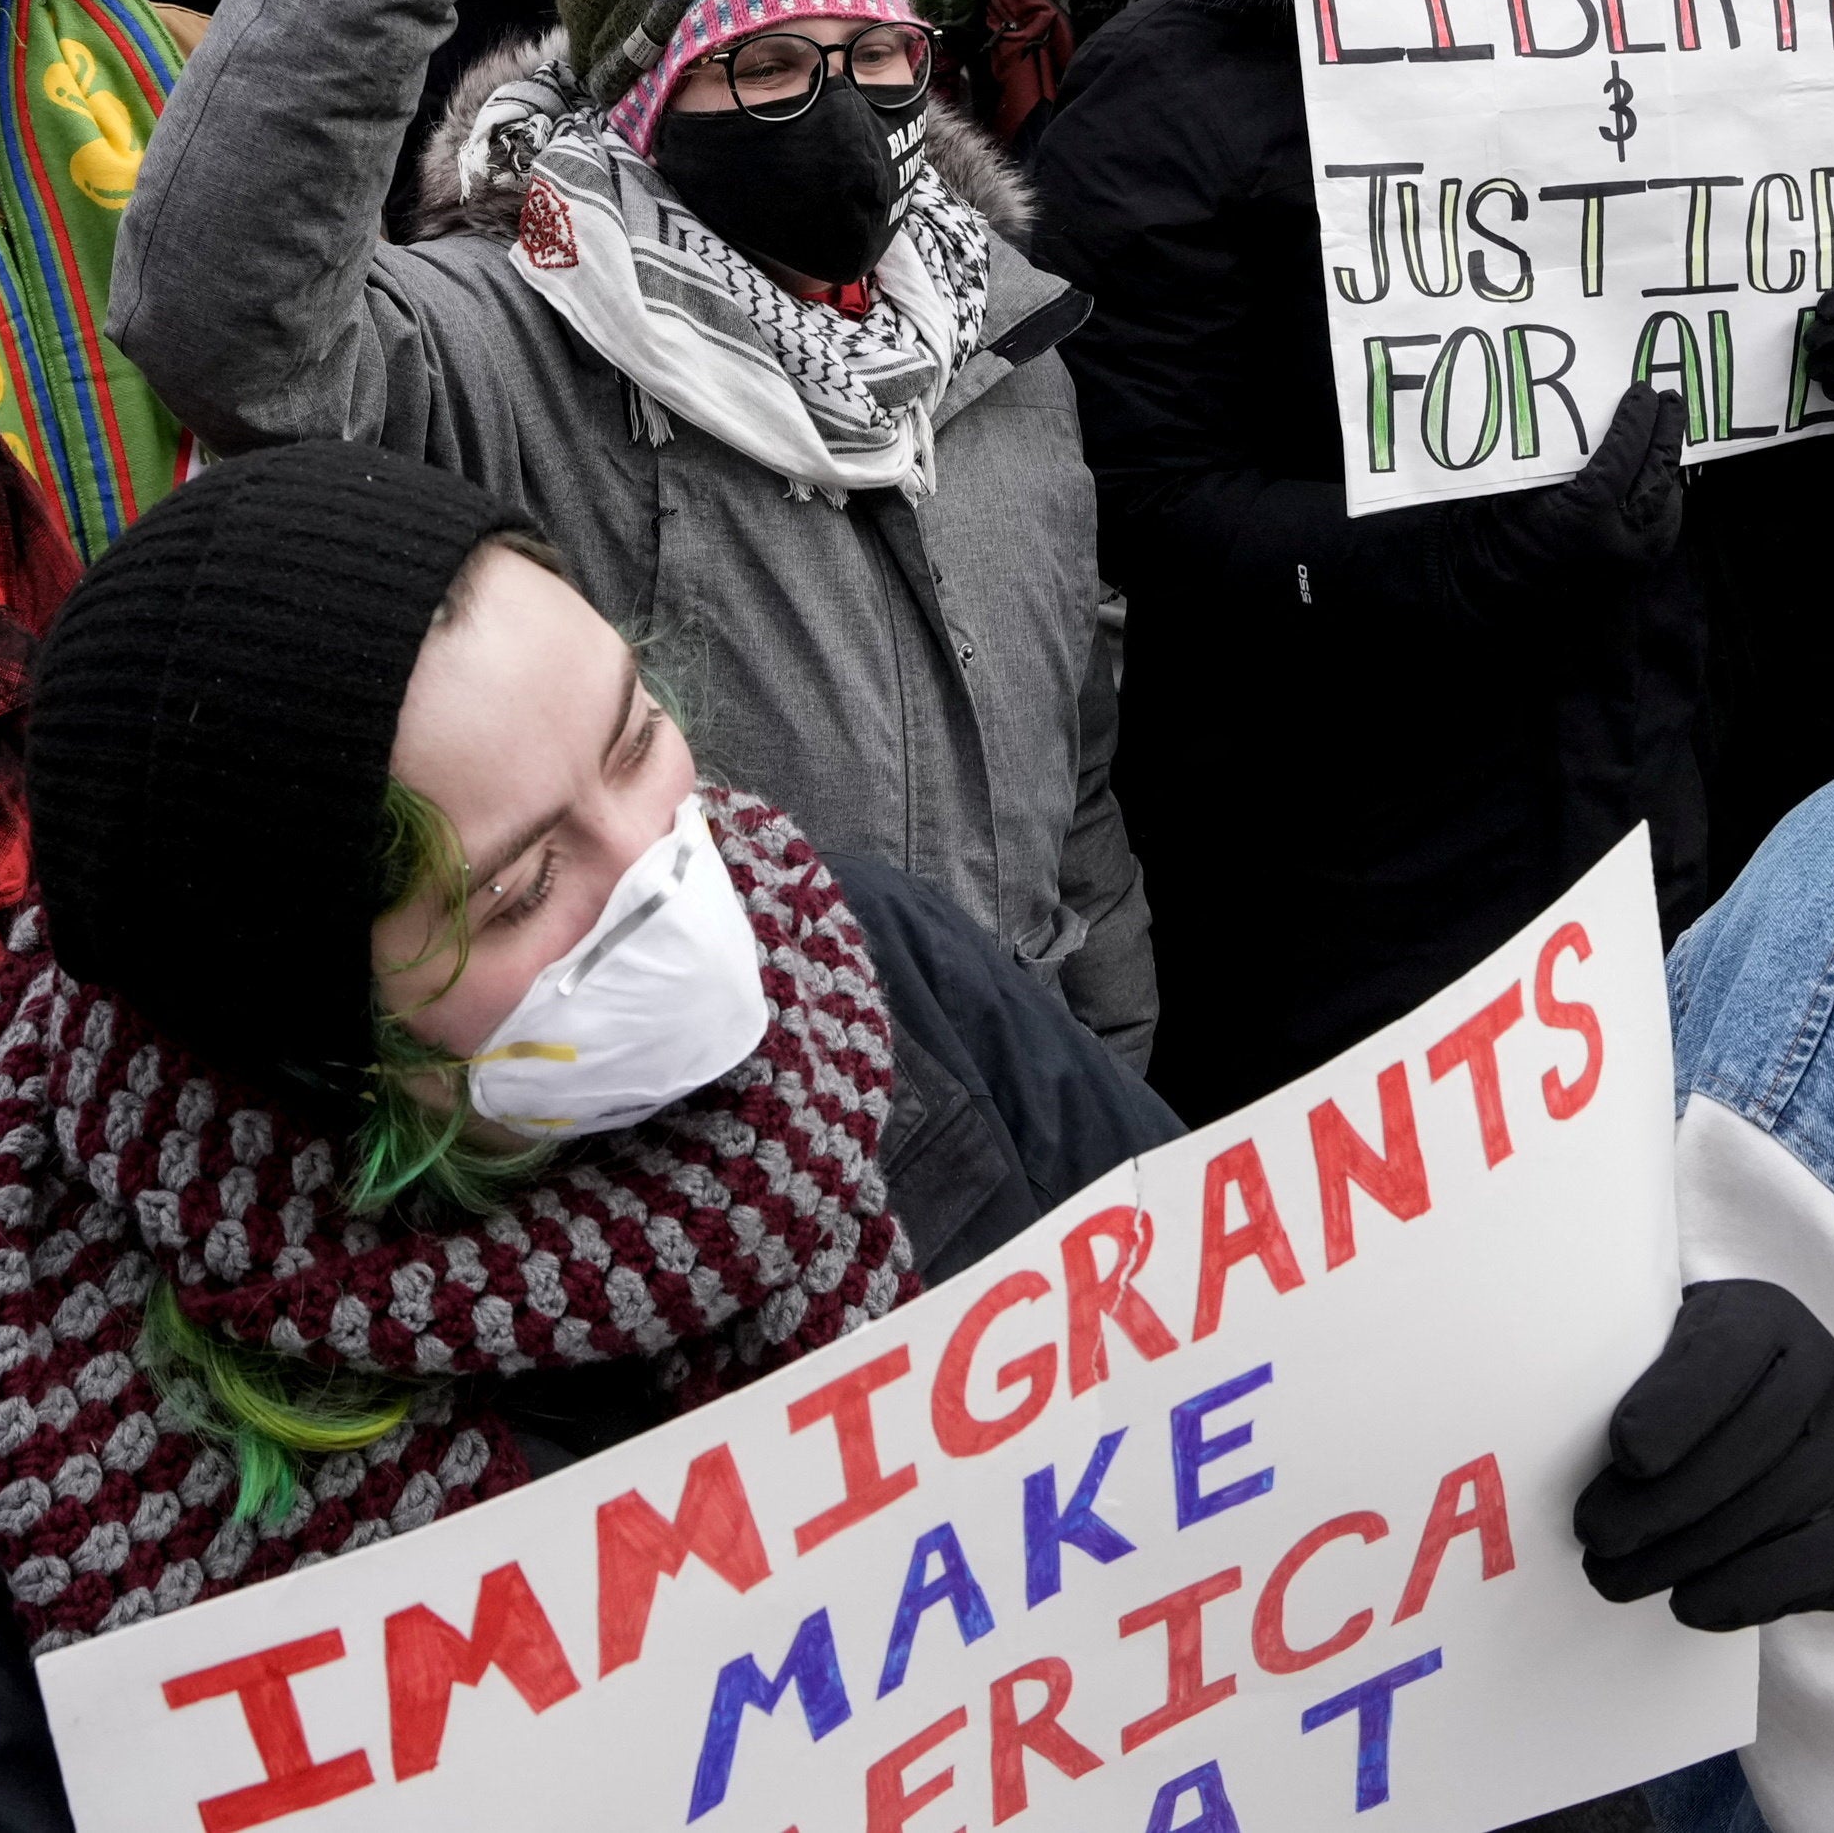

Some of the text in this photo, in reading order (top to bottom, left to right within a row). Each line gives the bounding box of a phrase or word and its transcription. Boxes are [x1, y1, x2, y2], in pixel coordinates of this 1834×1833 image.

[1362, 325, 1590, 473] FOR
[162, 918, 1607, 1833] IMMIGRANTS
[685, 1361, 1277, 1826] MAKE
[817, 1451, 1515, 1833] ERICA
